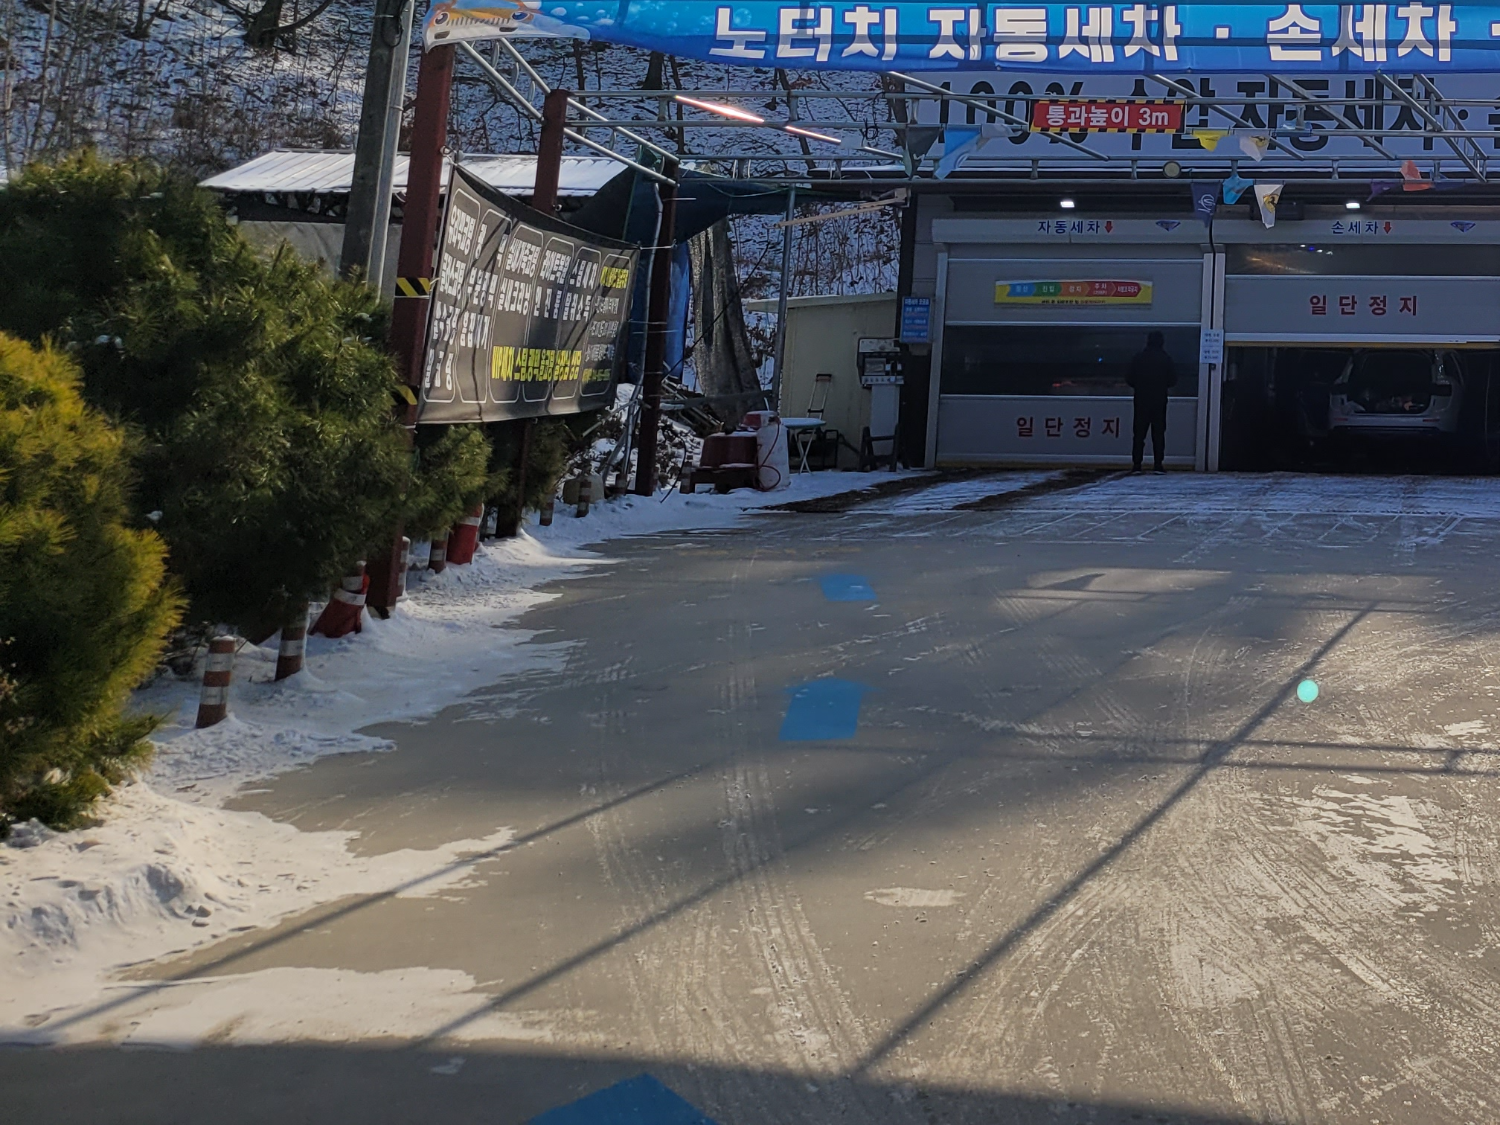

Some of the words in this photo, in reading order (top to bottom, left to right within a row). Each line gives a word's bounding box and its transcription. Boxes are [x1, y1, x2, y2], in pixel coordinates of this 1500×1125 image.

[709, 5, 899, 61] 노터치
[928, 5, 1181, 63] 자동세차
[1267, 3, 1456, 62] 손세차
[1045, 105, 1130, 127] 통과높이
[1138, 107, 1169, 126] 3m
[1237, 78, 1437, 151] 자동세차
[1038, 220, 1101, 234] 자동세차
[1331, 220, 1379, 235] 손세차
[1309, 293, 1419, 317] 일단정지
[1016, 416, 1121, 438] 일단정지
